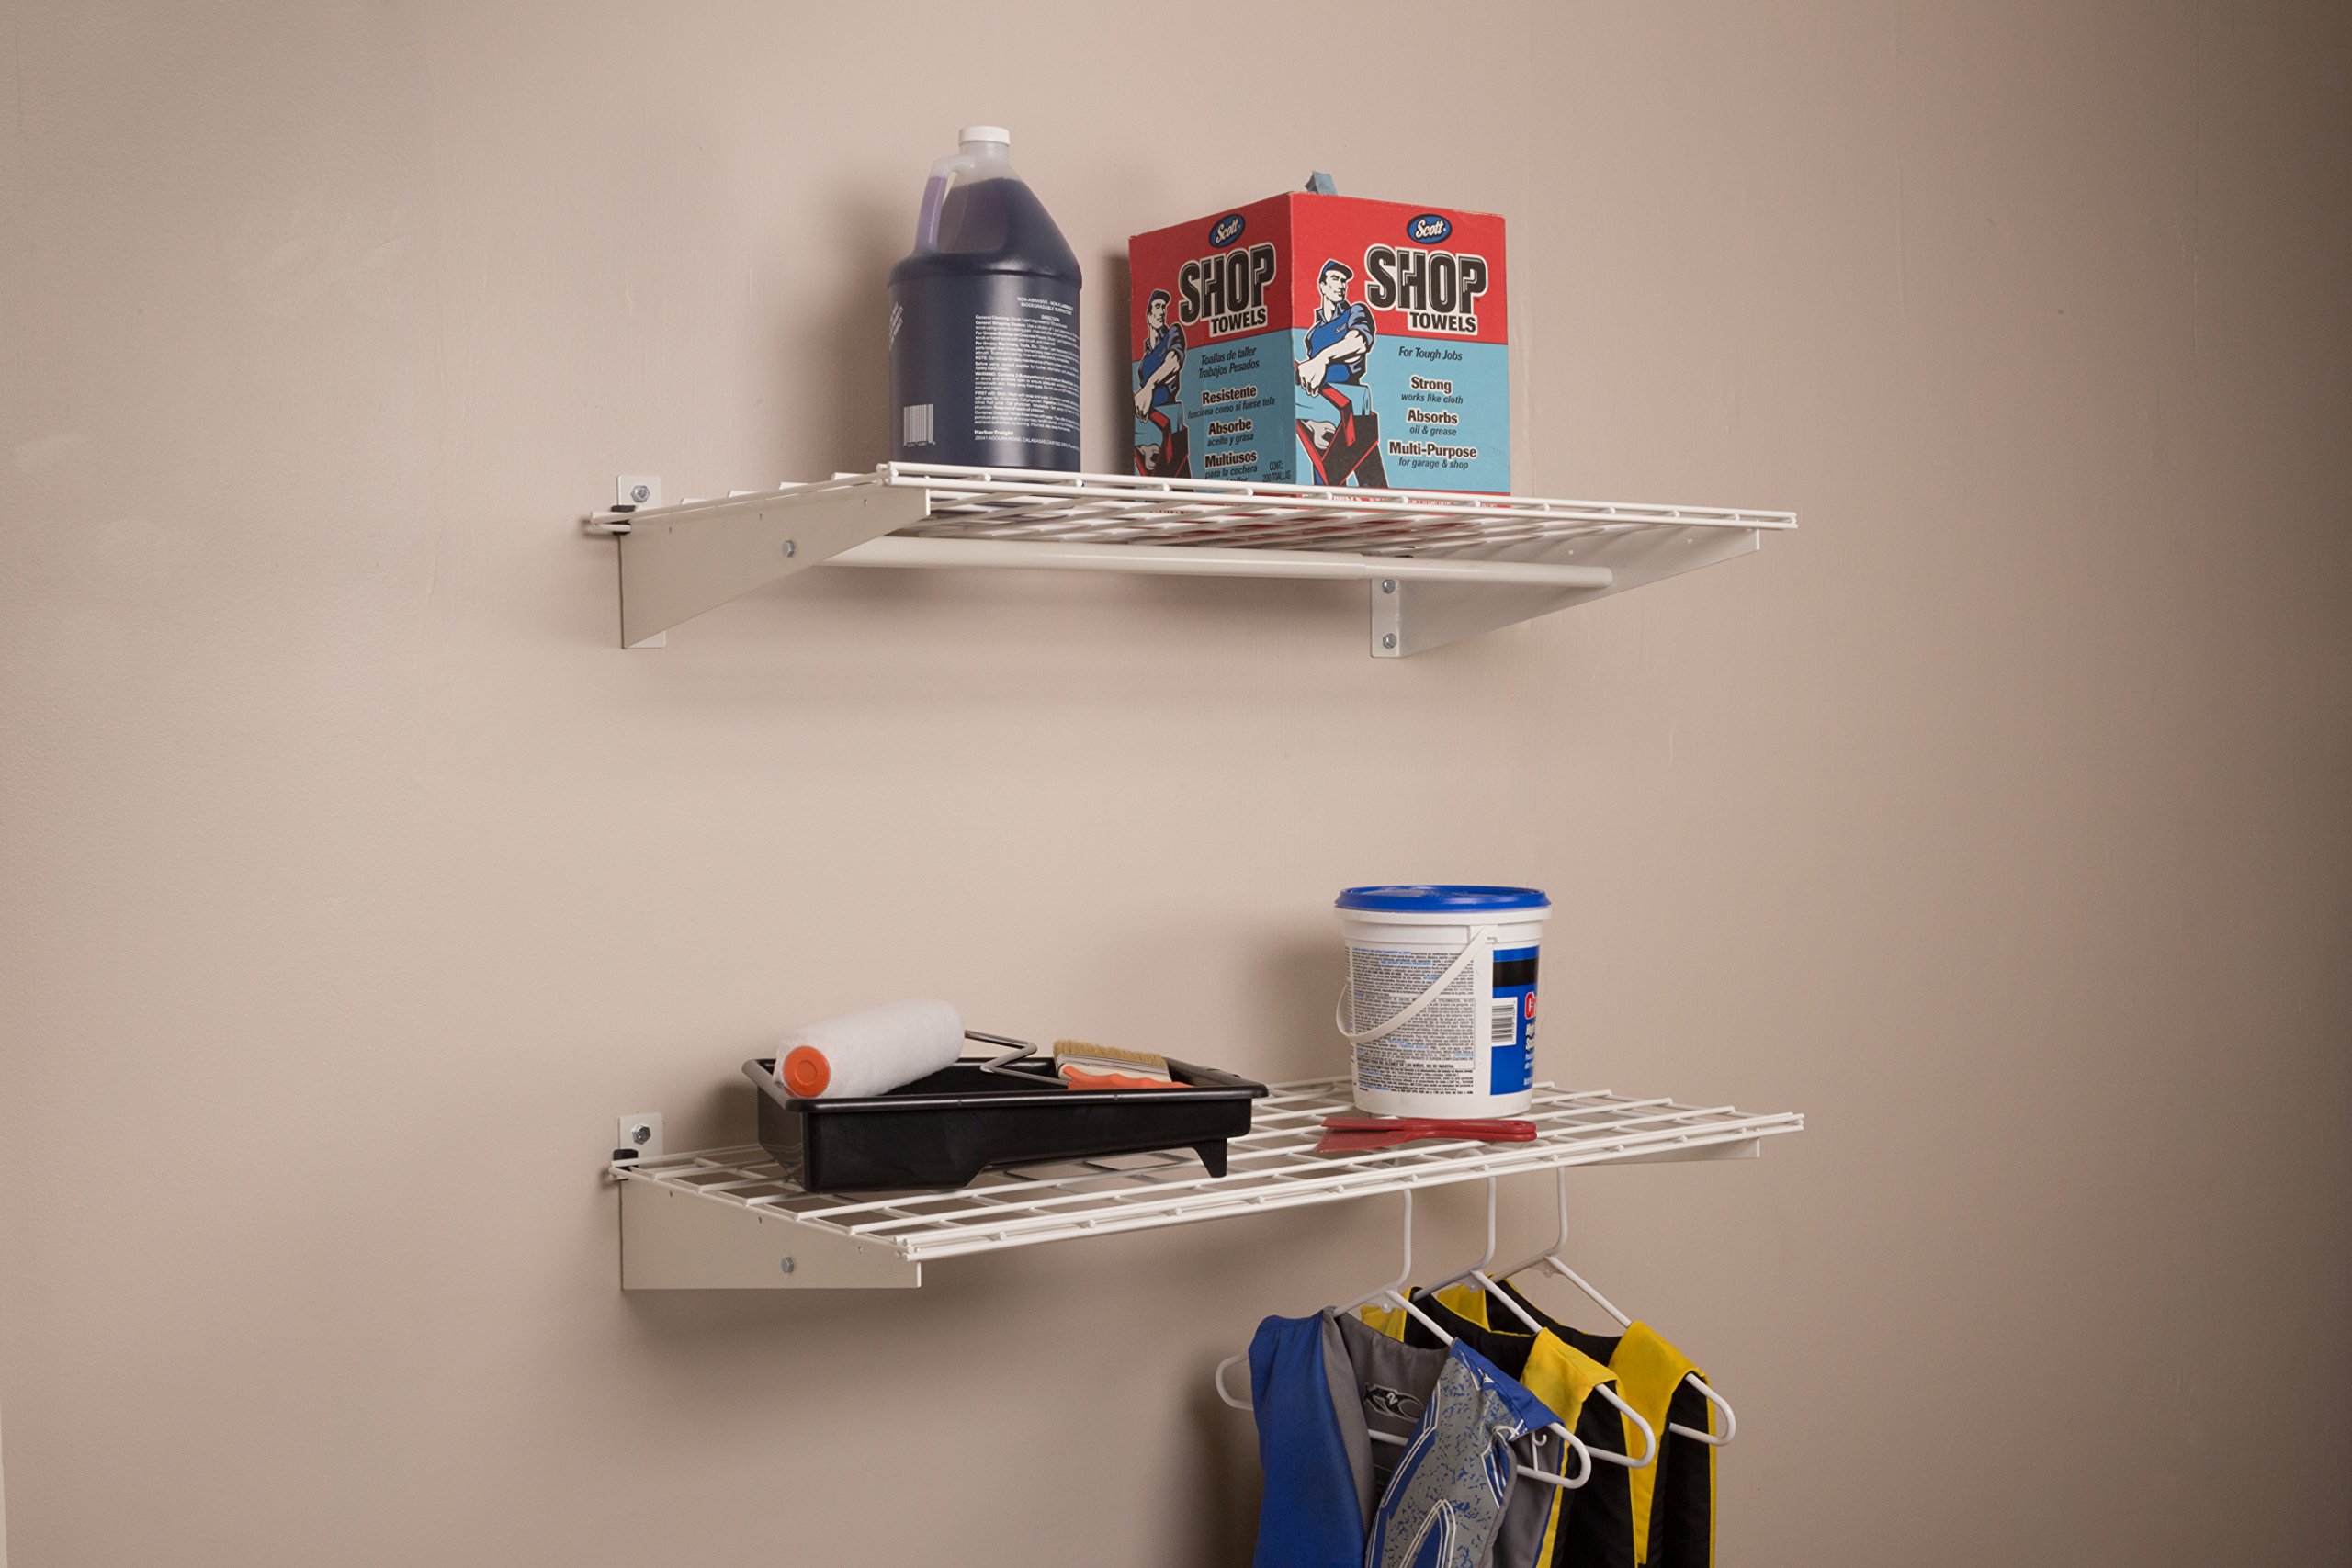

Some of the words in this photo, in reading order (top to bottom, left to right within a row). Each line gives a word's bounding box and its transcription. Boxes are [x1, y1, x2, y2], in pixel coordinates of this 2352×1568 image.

[1216, 218, 1239, 243] Scott
[1415, 220, 1444, 238] Scott
[1179, 243, 1275, 324] SHOP
[1365, 244, 1487, 315] SHOP
[1211, 308, 1266, 334] TOWELS
[1409, 312, 1476, 333] TOWELS
[1201, 354, 1225, 366] Toallas
[1227, 350, 1236, 361] de
[1238, 346, 1257, 358] taller
[1398, 346, 1413, 357] For
[1415, 347, 1441, 361] Tough
[1442, 350, 1463, 361] Jobs
[1199, 366, 1227, 378] Trabajos
[1229, 359, 1260, 374] Pesados
[1410, 376, 1452, 394] Strong
[1202, 387, 1257, 405] Resistente
[1401, 393, 1425, 402] works
[1427, 394, 1442, 403] like
[1443, 395, 1464, 405] cloth
[1188, 408, 1214, 419] funciona
[1215, 405, 1234, 414] como
[1235, 402, 1241, 412] si
[1242, 400, 1261, 411] fuese
[1262, 396, 1276, 406] tela
[1408, 409, 1458, 424] Absorbs
[1208, 419, 1252, 435] Absorbe
[1409, 425, 1420, 434] oil
[1422, 425, 1430, 434] &
[1430, 427, 1457, 437] grease
[1207, 435, 1228, 447] aceite
[1229, 437, 1235, 446] y
[1235, 433, 1254, 446] grasa
[1389, 441, 1477, 459] Multi-Purpose
[1204, 451, 1257, 468] Multiusos
[1398, 457, 1410, 467] for
[1412, 459, 1440, 469] garage
[1441, 459, 1448, 468] &
[1450, 459, 1469, 470] shop
[1205, 470, 1221, 479] para
[1222, 468, 1229, 477] la
[1230, 465, 1258, 476] cochera
